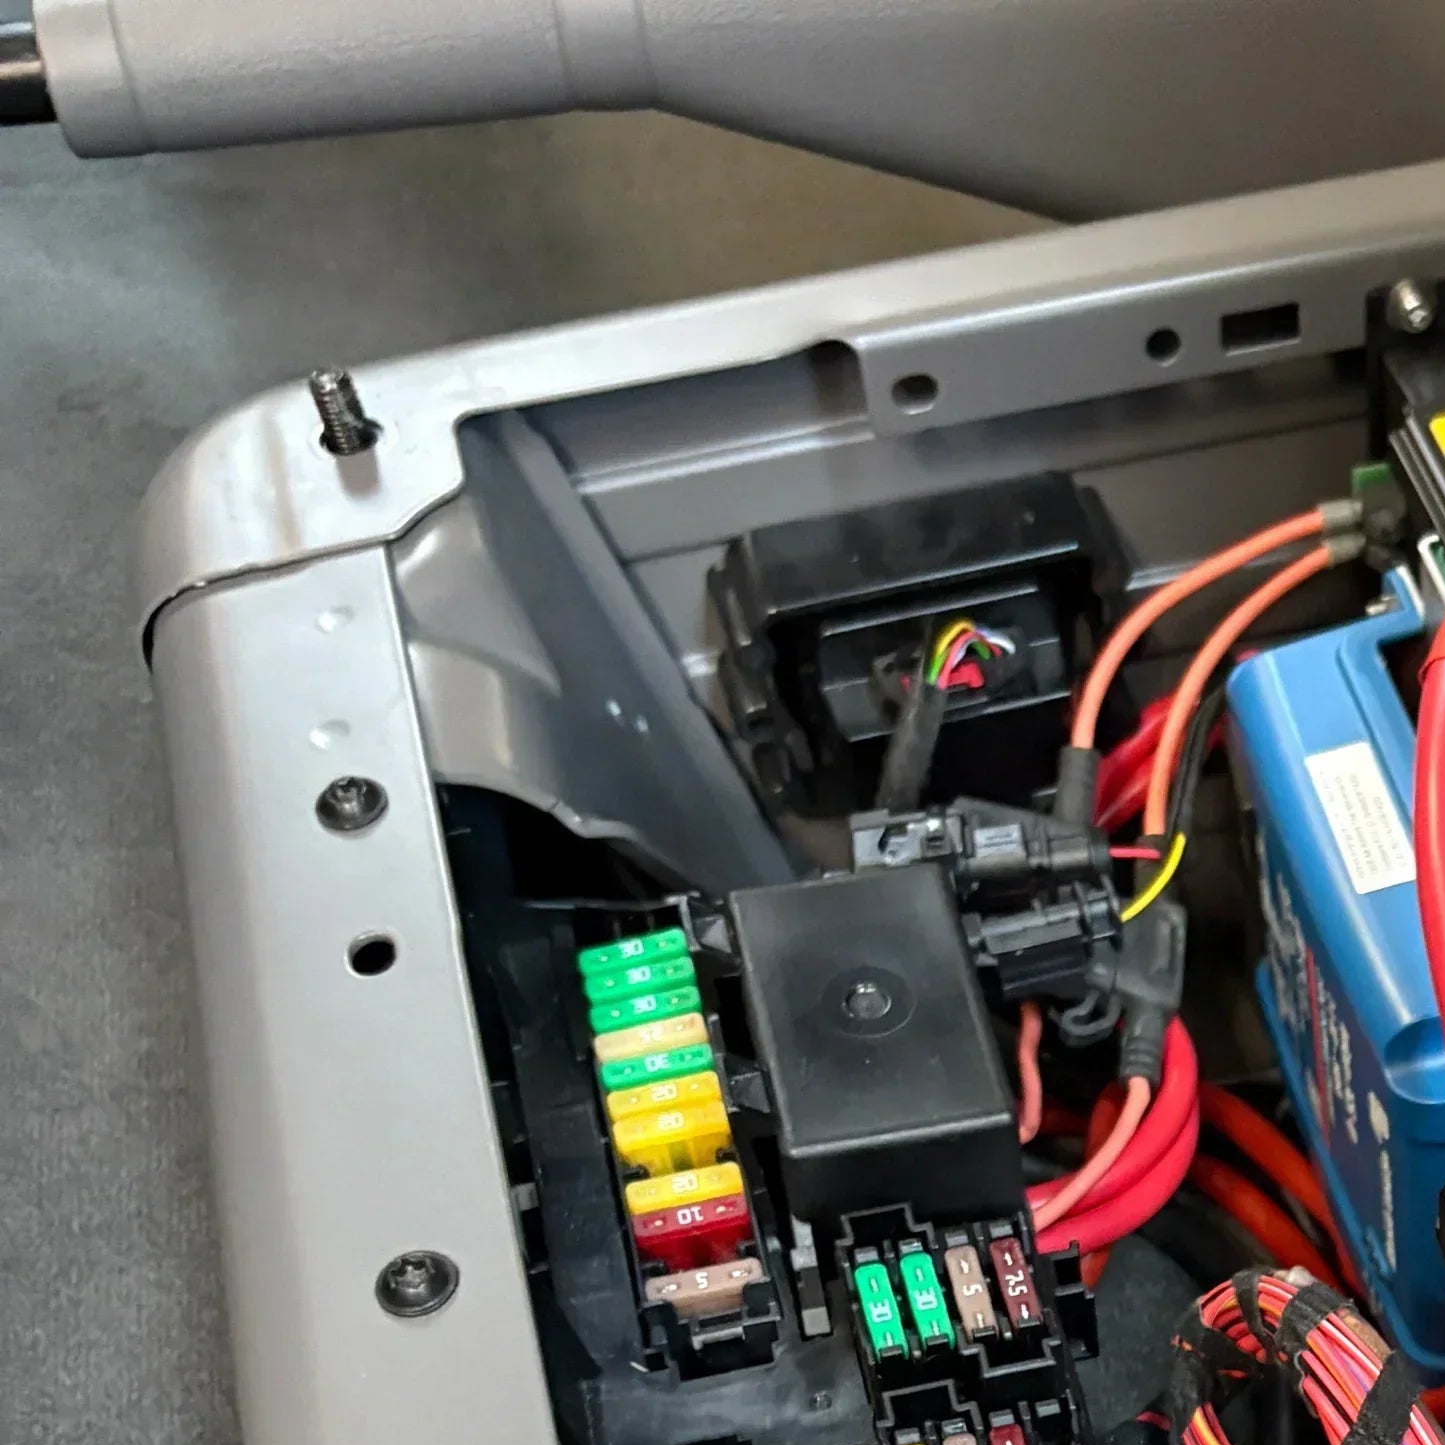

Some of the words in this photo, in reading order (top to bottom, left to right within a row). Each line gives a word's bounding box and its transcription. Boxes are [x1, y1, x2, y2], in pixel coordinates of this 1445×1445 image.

[646, 1054, 670, 1072] 30
[678, 1209, 704, 1225] 10
[696, 1272, 708, 1289] 5
[1005, 1270, 1028, 1297] 7.5
[914, 1286, 937, 1310] 30
[963, 1284, 982, 1296] 5
[870, 1299, 892, 1322] 30
